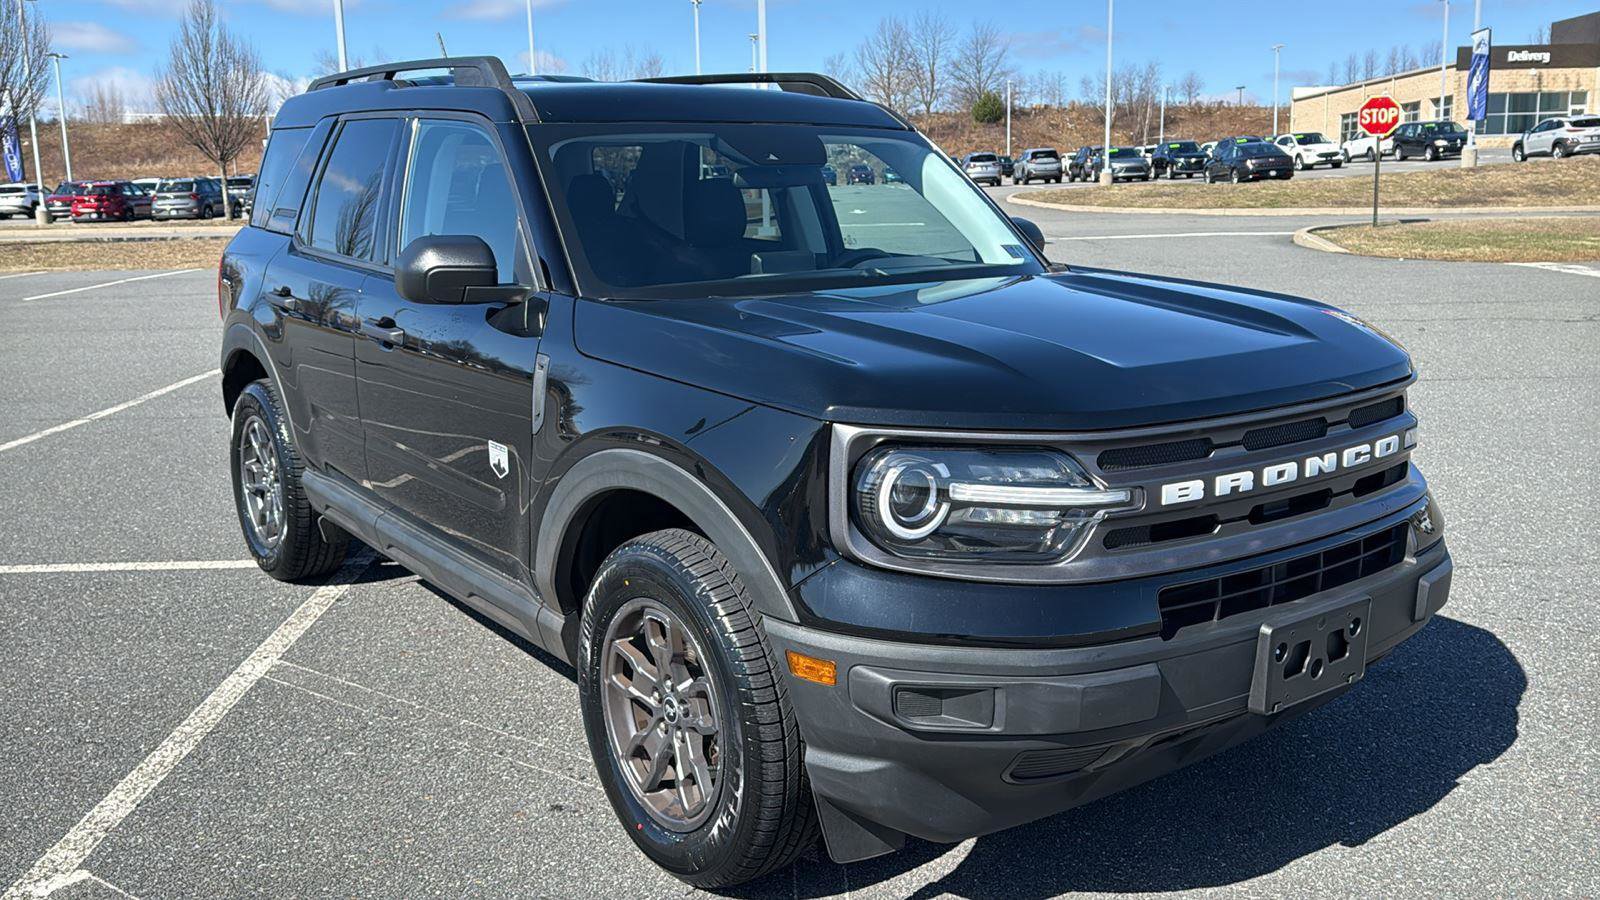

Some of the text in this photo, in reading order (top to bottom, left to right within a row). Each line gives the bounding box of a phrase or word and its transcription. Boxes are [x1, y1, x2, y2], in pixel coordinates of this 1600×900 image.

[1508, 50, 1550, 64] Delivery
[1361, 107, 1398, 124] STOP
[1161, 434, 1399, 506] BRONCO
